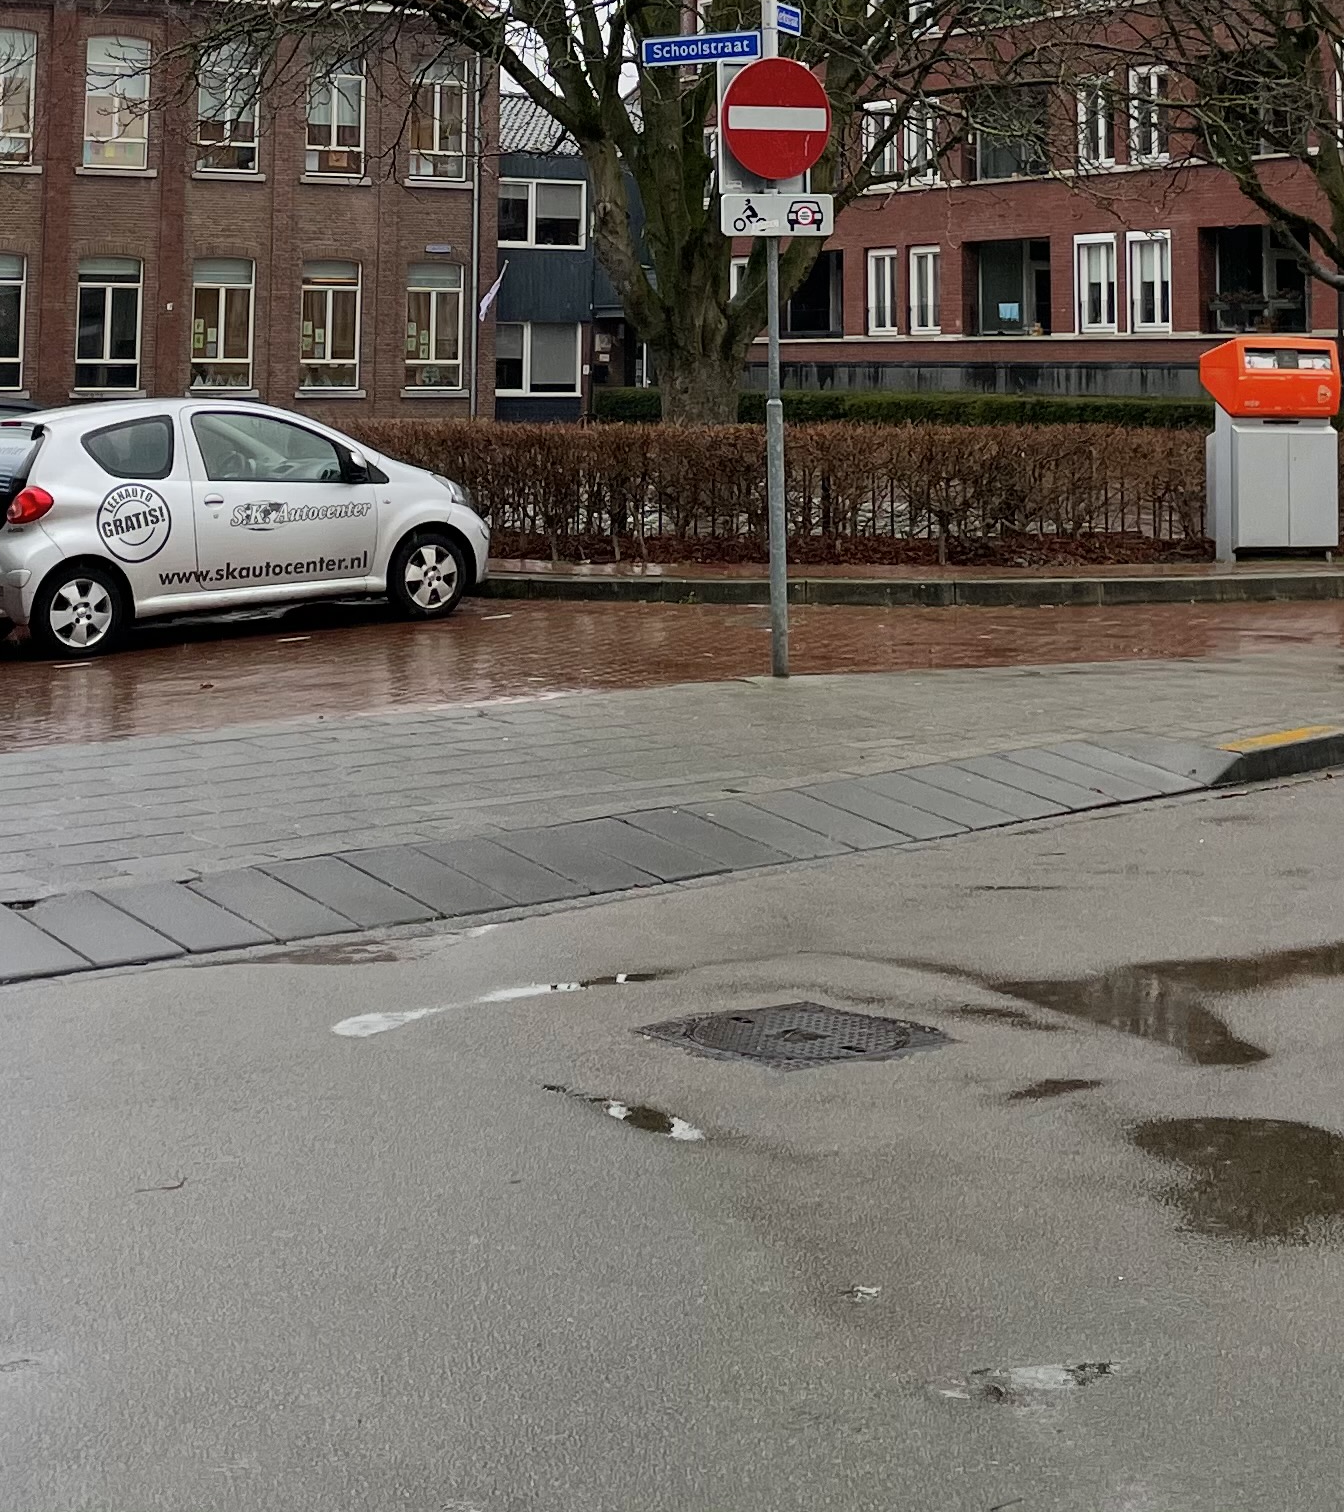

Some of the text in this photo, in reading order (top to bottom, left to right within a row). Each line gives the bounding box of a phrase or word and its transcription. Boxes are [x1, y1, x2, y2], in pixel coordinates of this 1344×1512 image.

[653, 40, 750, 59] Schoolstraat
[104, 488, 153, 513] LEENAUTO
[102, 506, 166, 538] GRATIS!
[230, 501, 371, 527] S.K. Autocenter
[159, 551, 368, 586] www.skautocenter.nl
